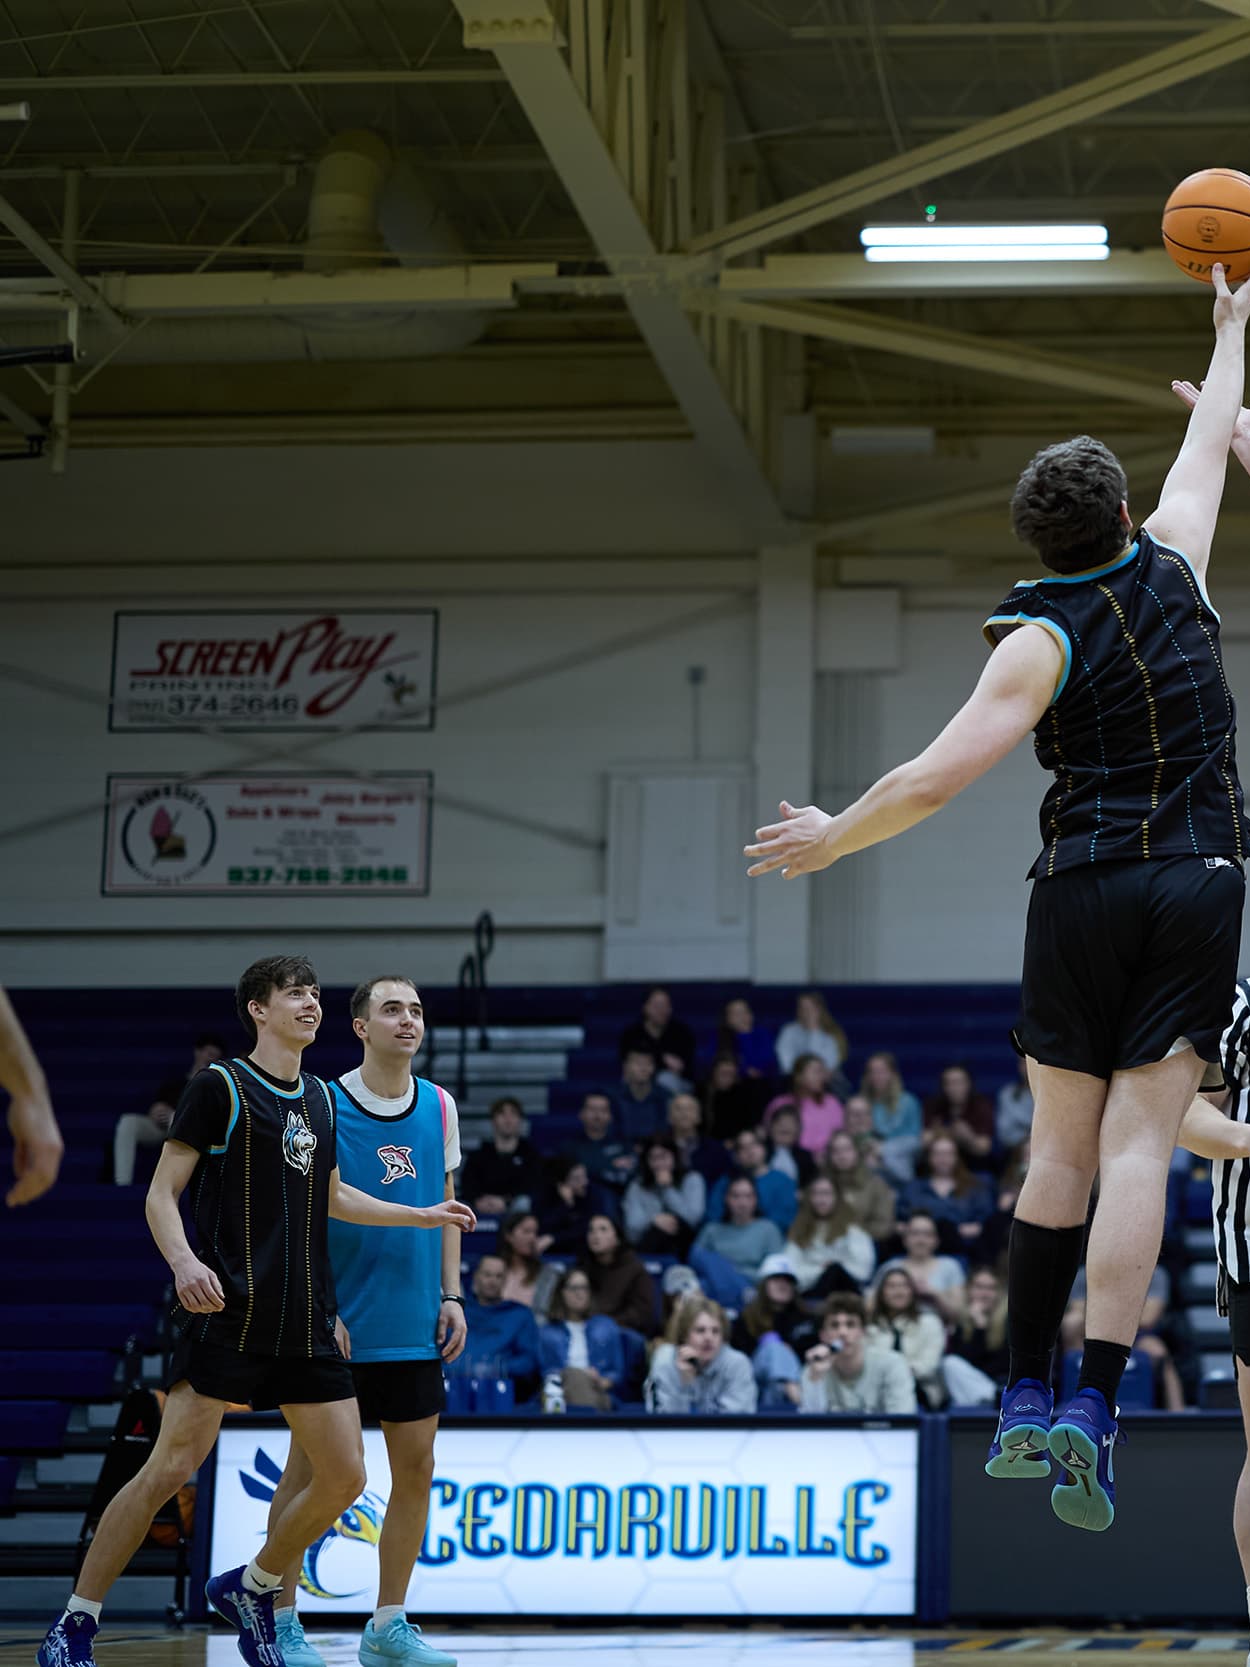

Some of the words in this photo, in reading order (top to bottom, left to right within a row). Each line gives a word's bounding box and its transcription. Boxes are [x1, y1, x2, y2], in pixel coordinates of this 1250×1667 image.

[129, 630, 284, 678] SCREEN
[275, 614, 398, 718] Play
[129, 680, 270, 692] PRINTING
[167, 694, 299, 716] 374-2646
[416, 1477, 890, 1568] CEDARVILLE
